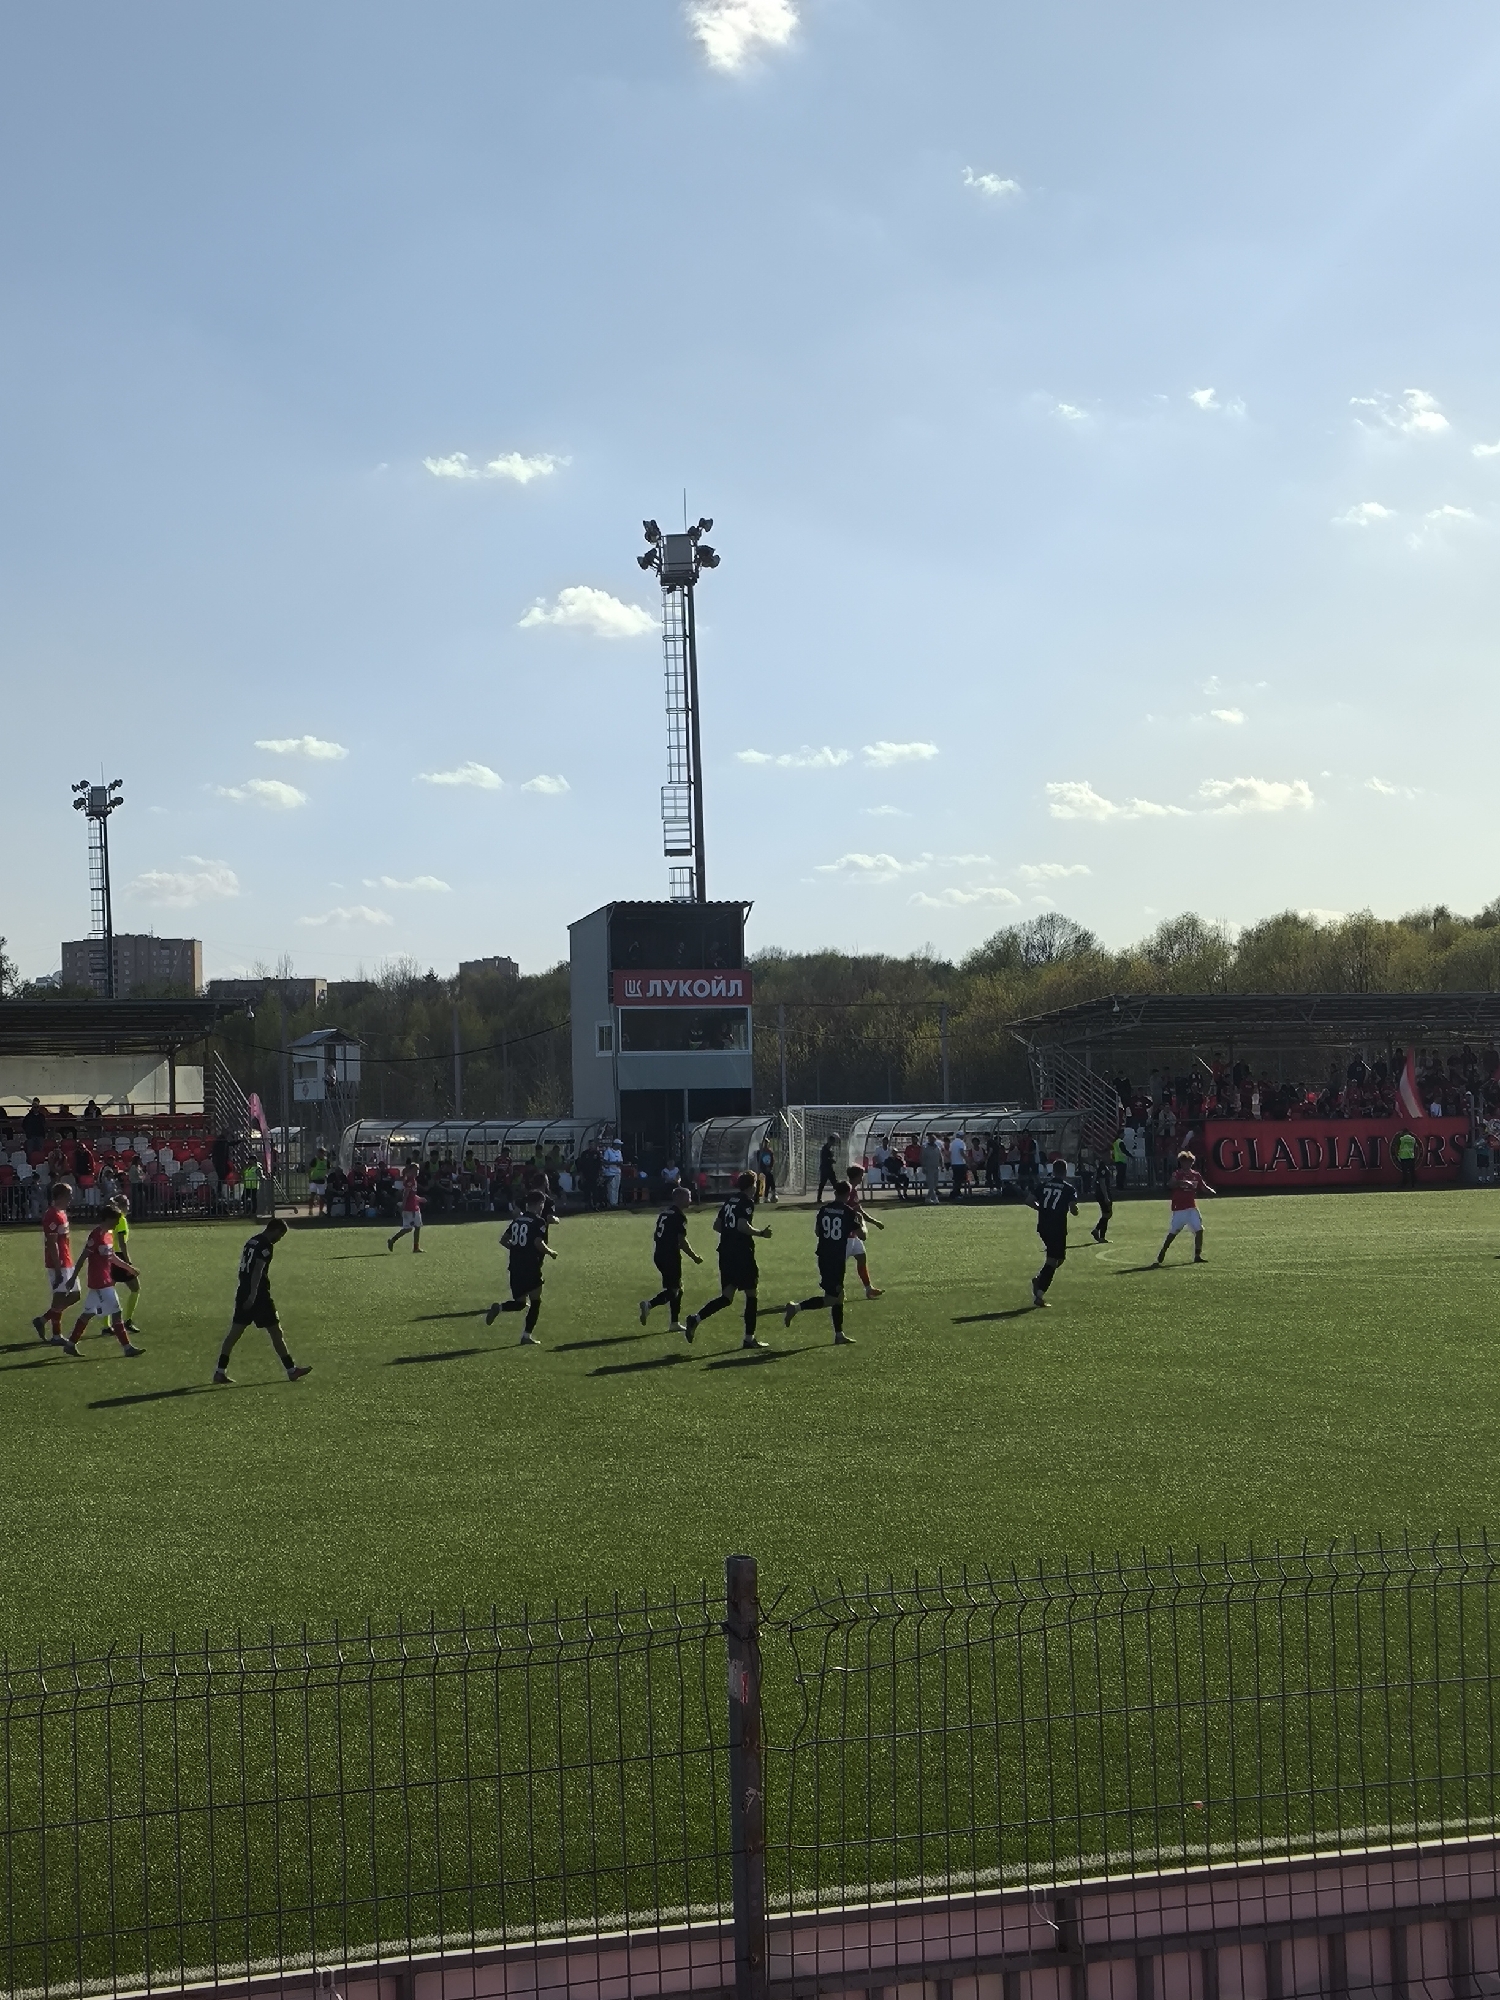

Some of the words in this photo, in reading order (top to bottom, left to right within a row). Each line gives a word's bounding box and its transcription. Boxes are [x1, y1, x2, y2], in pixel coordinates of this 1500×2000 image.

[646, 975, 743, 998] ЛУКОЙЛ
[1212, 1131, 1469, 1173] GLADIATORS
[1043, 1187, 1062, 1211] 77
[821, 1215, 842, 1241] 98
